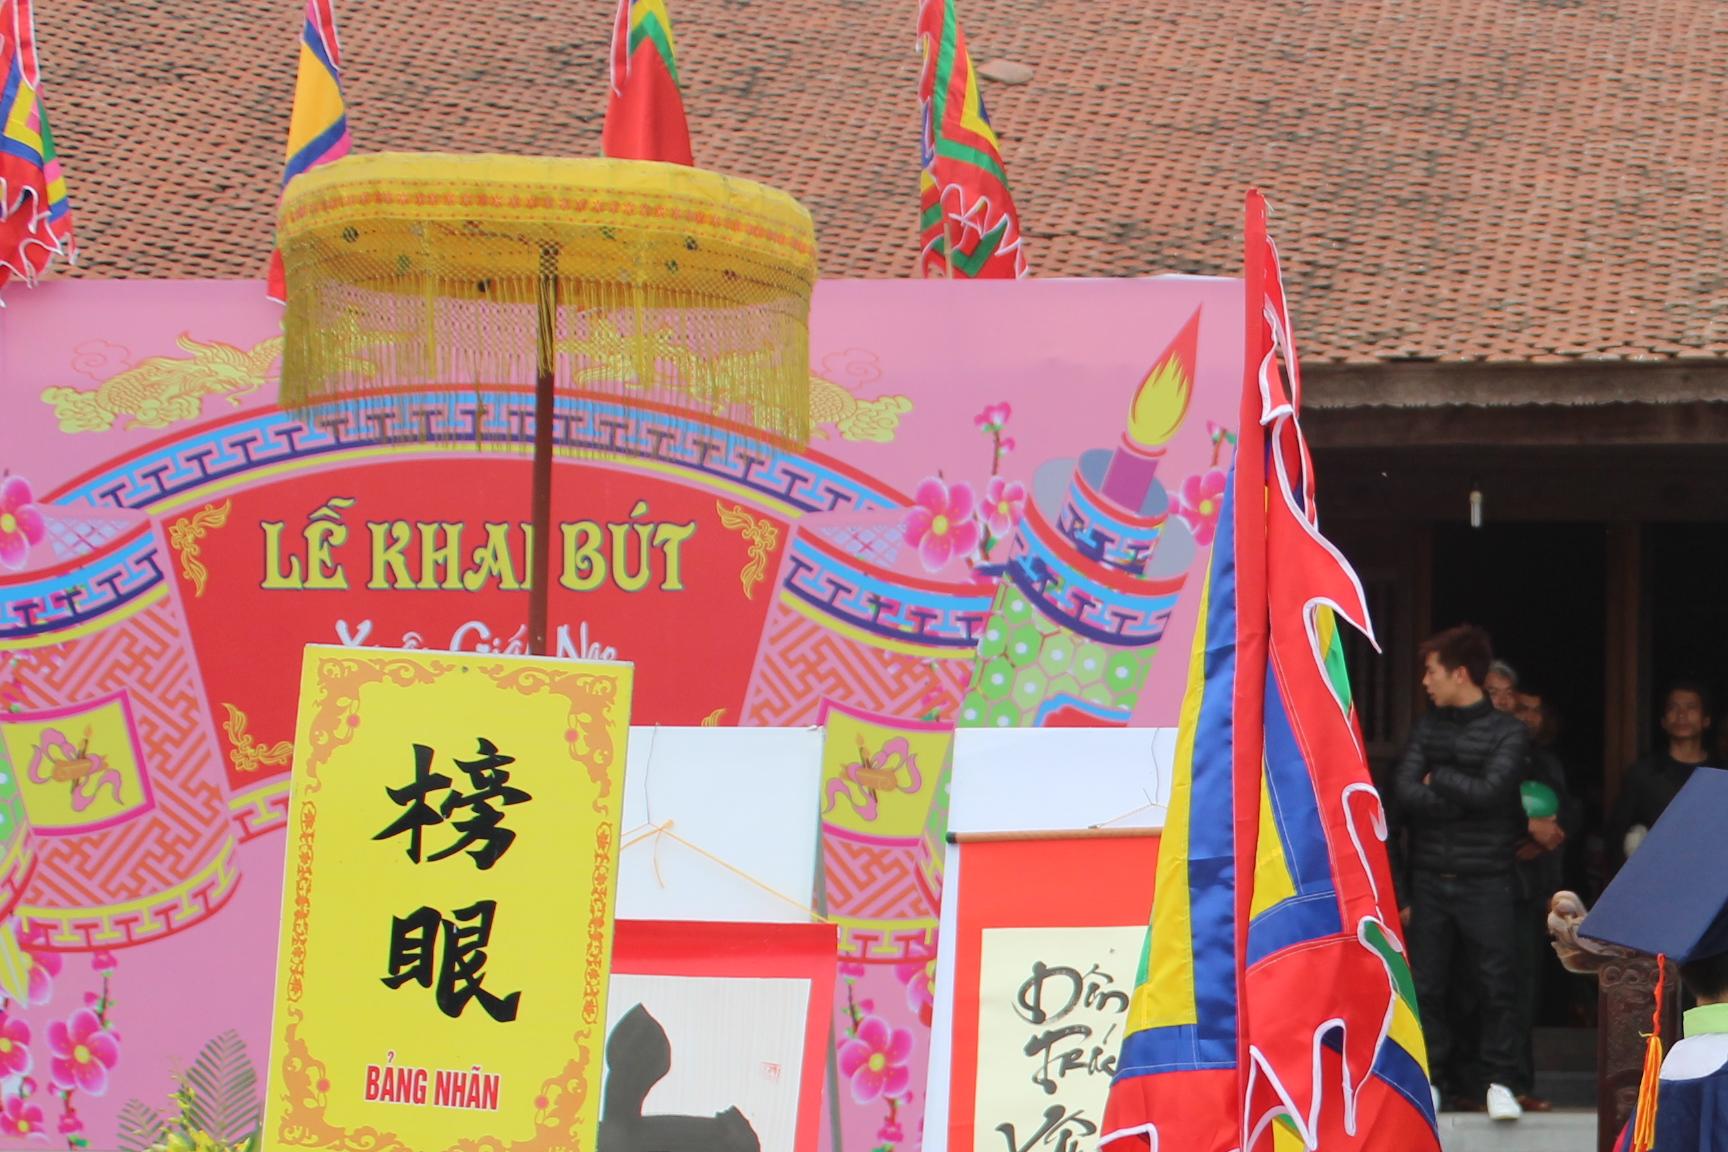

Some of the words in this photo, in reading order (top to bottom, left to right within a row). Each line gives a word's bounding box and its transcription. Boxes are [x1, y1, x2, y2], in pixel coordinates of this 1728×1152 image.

[260, 498, 355, 590] LỄ
[560, 500, 696, 592] BÚT
[370, 736, 533, 1023] 榜眼
[364, 1050, 428, 1106] BẢNG
[433, 1066, 500, 1111] NHÃN
